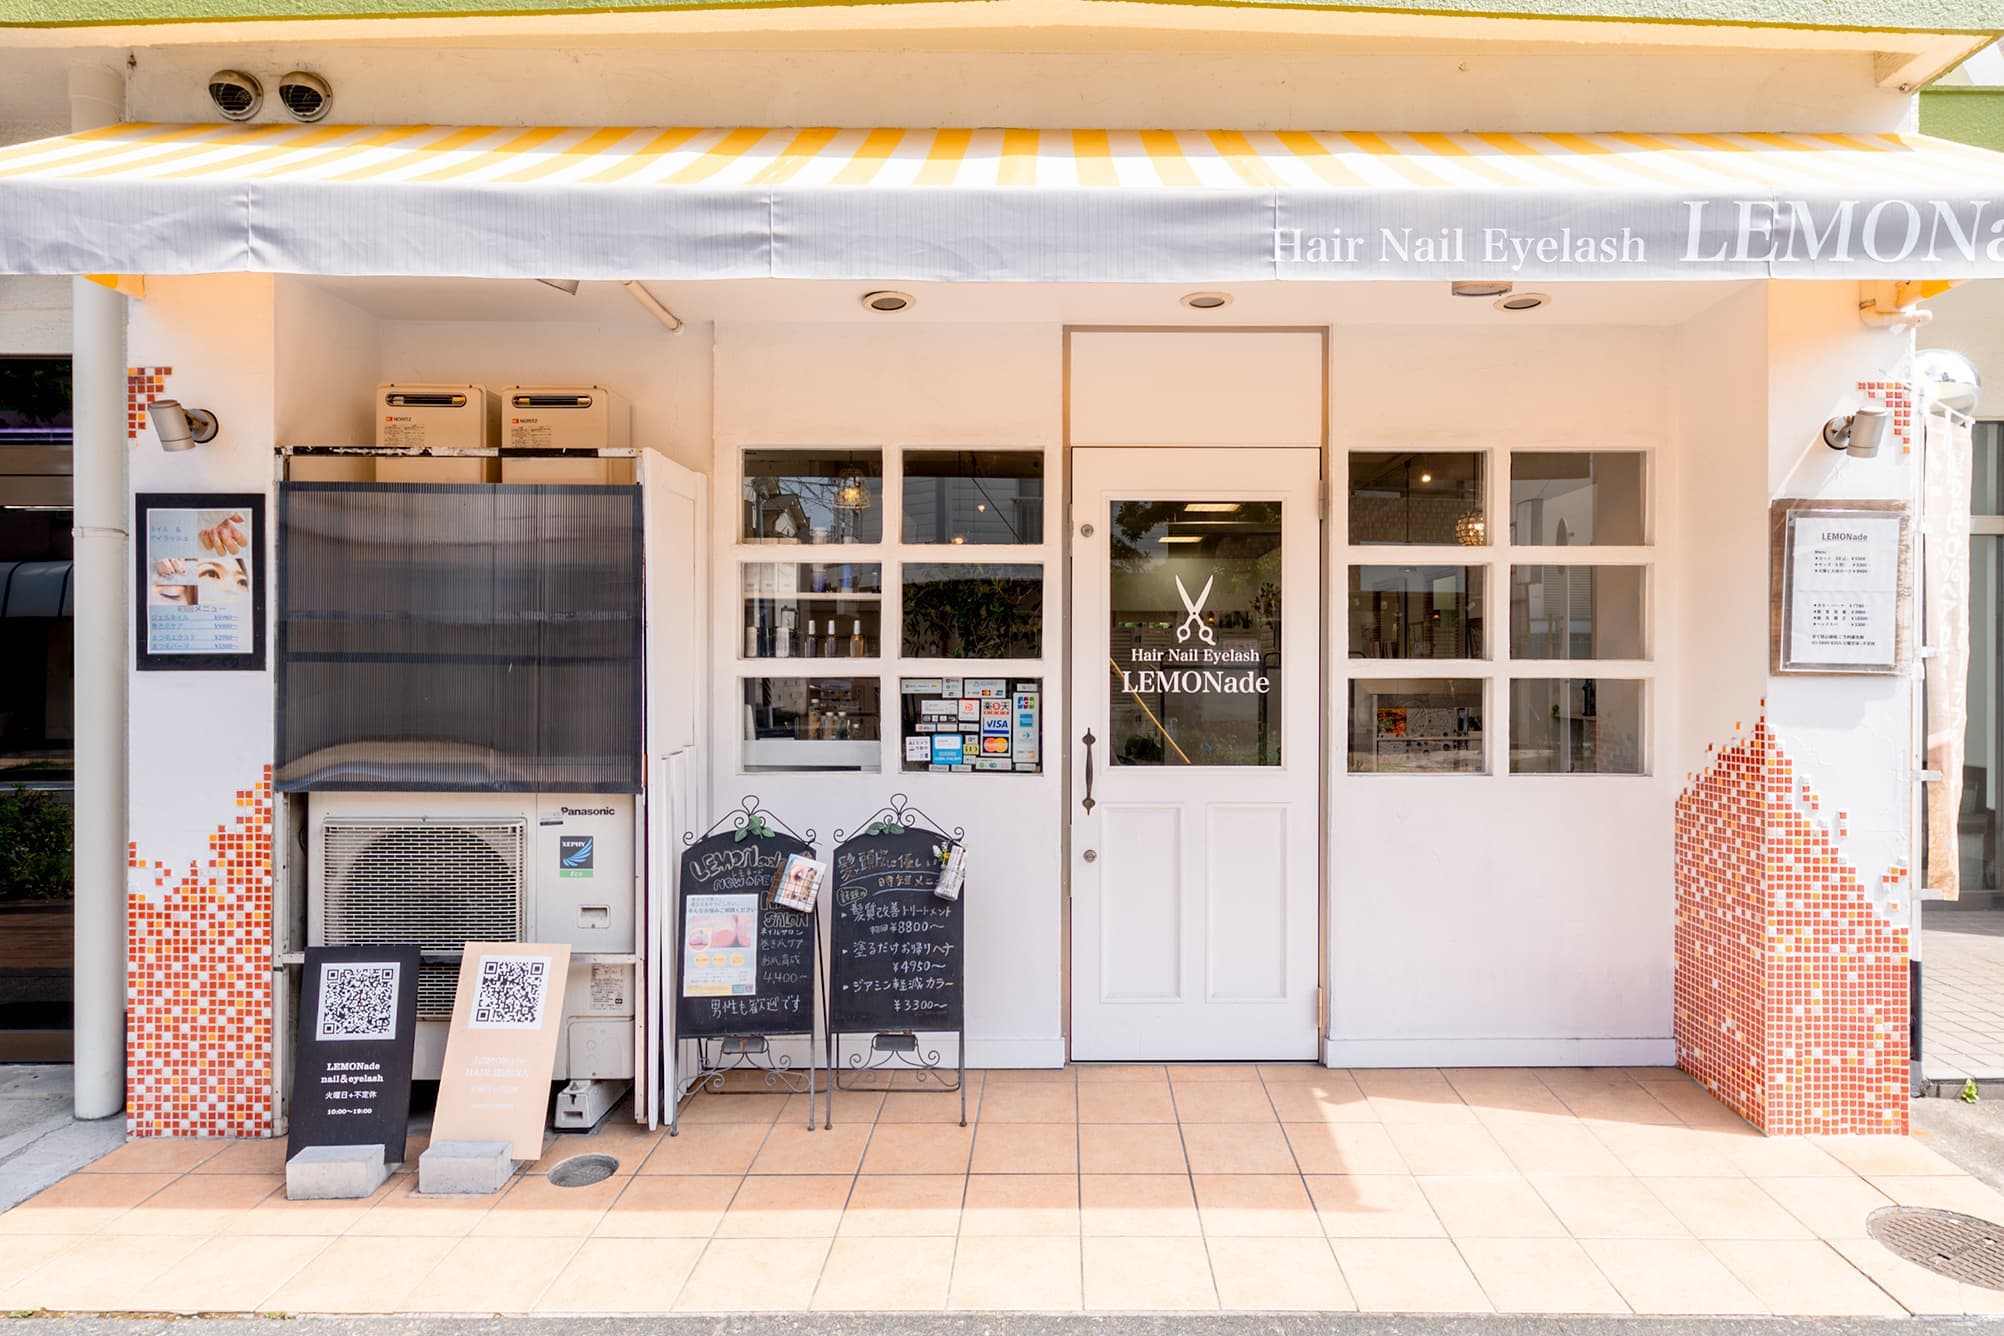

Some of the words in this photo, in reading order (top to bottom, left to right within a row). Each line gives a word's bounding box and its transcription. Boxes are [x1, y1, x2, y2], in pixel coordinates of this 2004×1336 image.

[1273, 228, 1364, 264] Hair
[1378, 228, 1465, 264] Nail
[1482, 228, 1648, 271] Eyelash
[1821, 532, 1868, 542] LEMONade
[1131, 649, 1164, 662] Hair
[1168, 649, 1198, 662] Nail
[1203, 649, 1260, 665] Eyelash
[1121, 670, 1270, 694] LEMONade
[986, 719, 1009, 728] VISA
[560, 806, 616, 816] Panasonic
[745, 874, 773, 888] OPE
[763, 911, 809, 928] SALON
[853, 940, 955, 958] 塗るだけお帰りヘナ
[853, 977, 955, 992] ジアミン軽減カラー
[710, 994, 801, 1019] 男性も歓迎です
[326, 1062, 381, 1072] LEMONade
